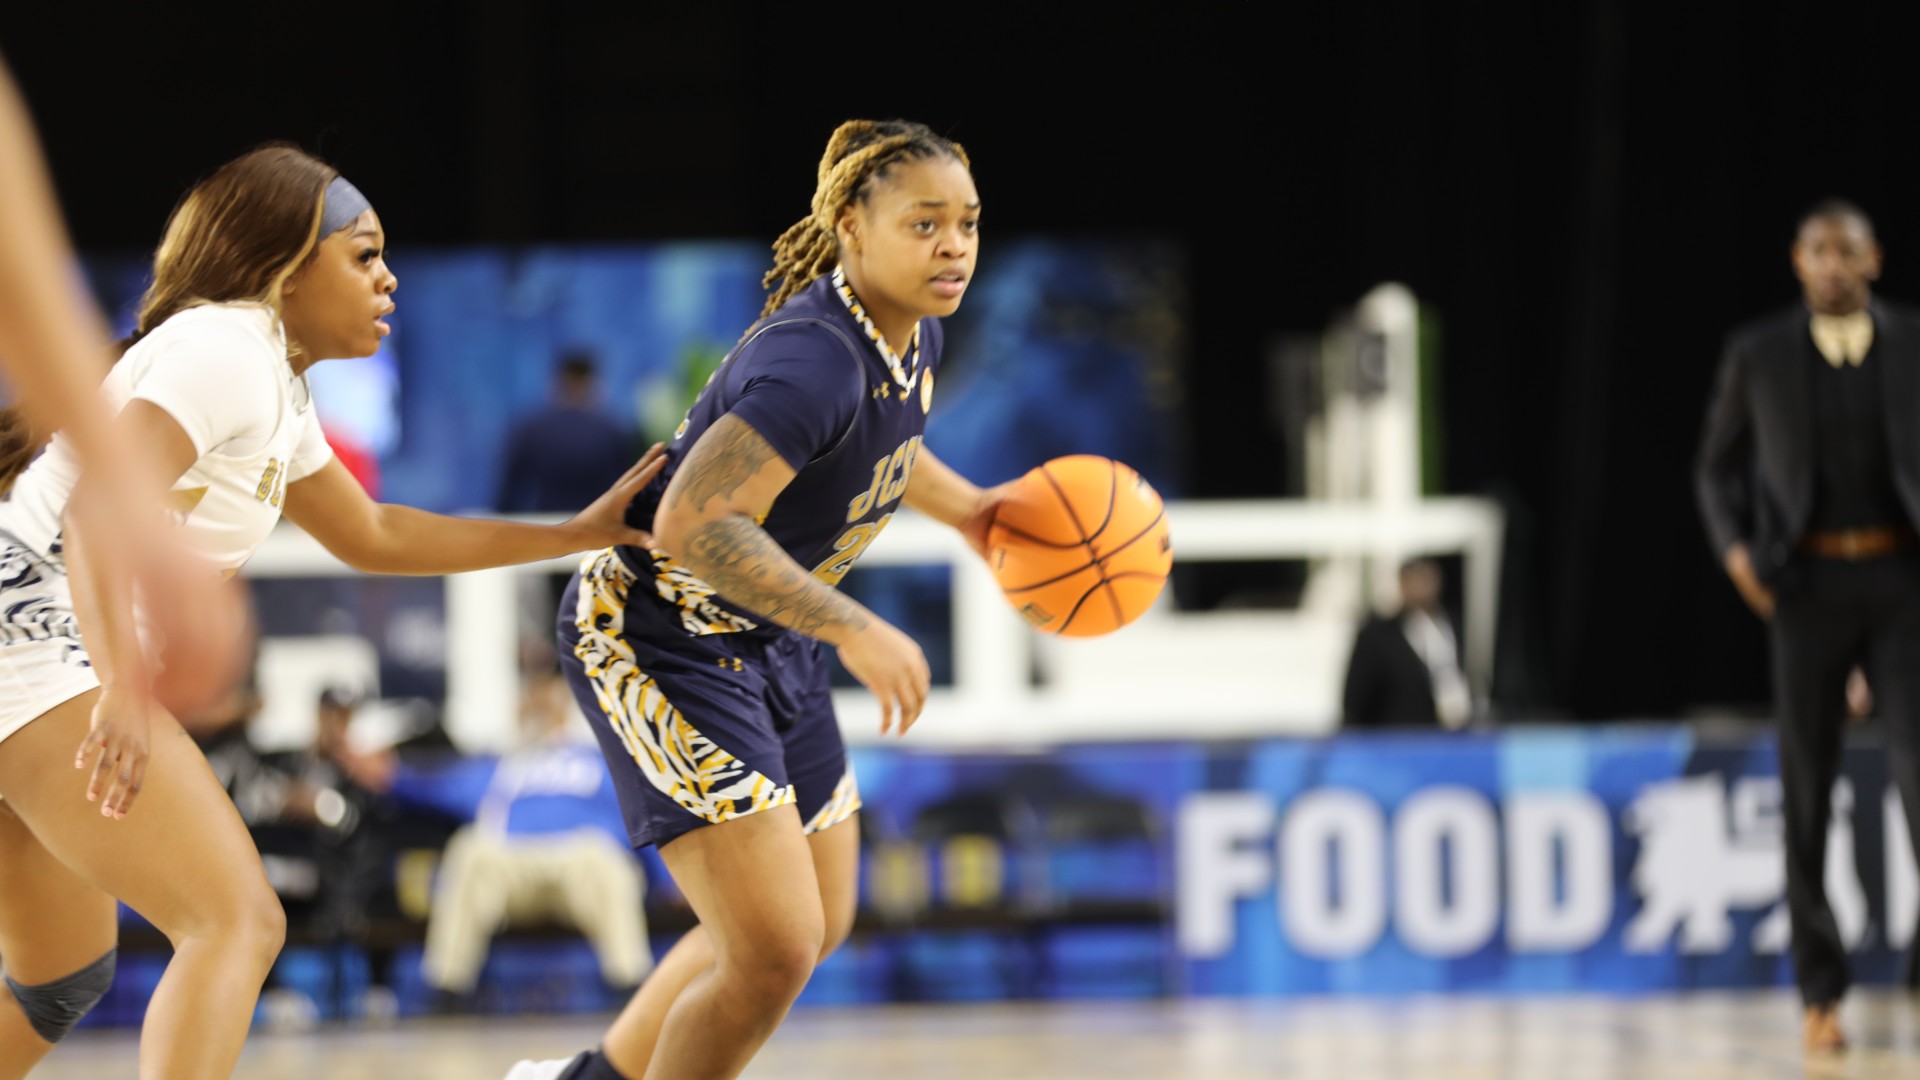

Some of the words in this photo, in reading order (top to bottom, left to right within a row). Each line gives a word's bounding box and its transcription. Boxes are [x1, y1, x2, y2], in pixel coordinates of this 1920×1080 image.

[846, 434, 924, 523] JCS
[809, 512, 893, 588] 2
[1176, 786, 1614, 957] FOOD
